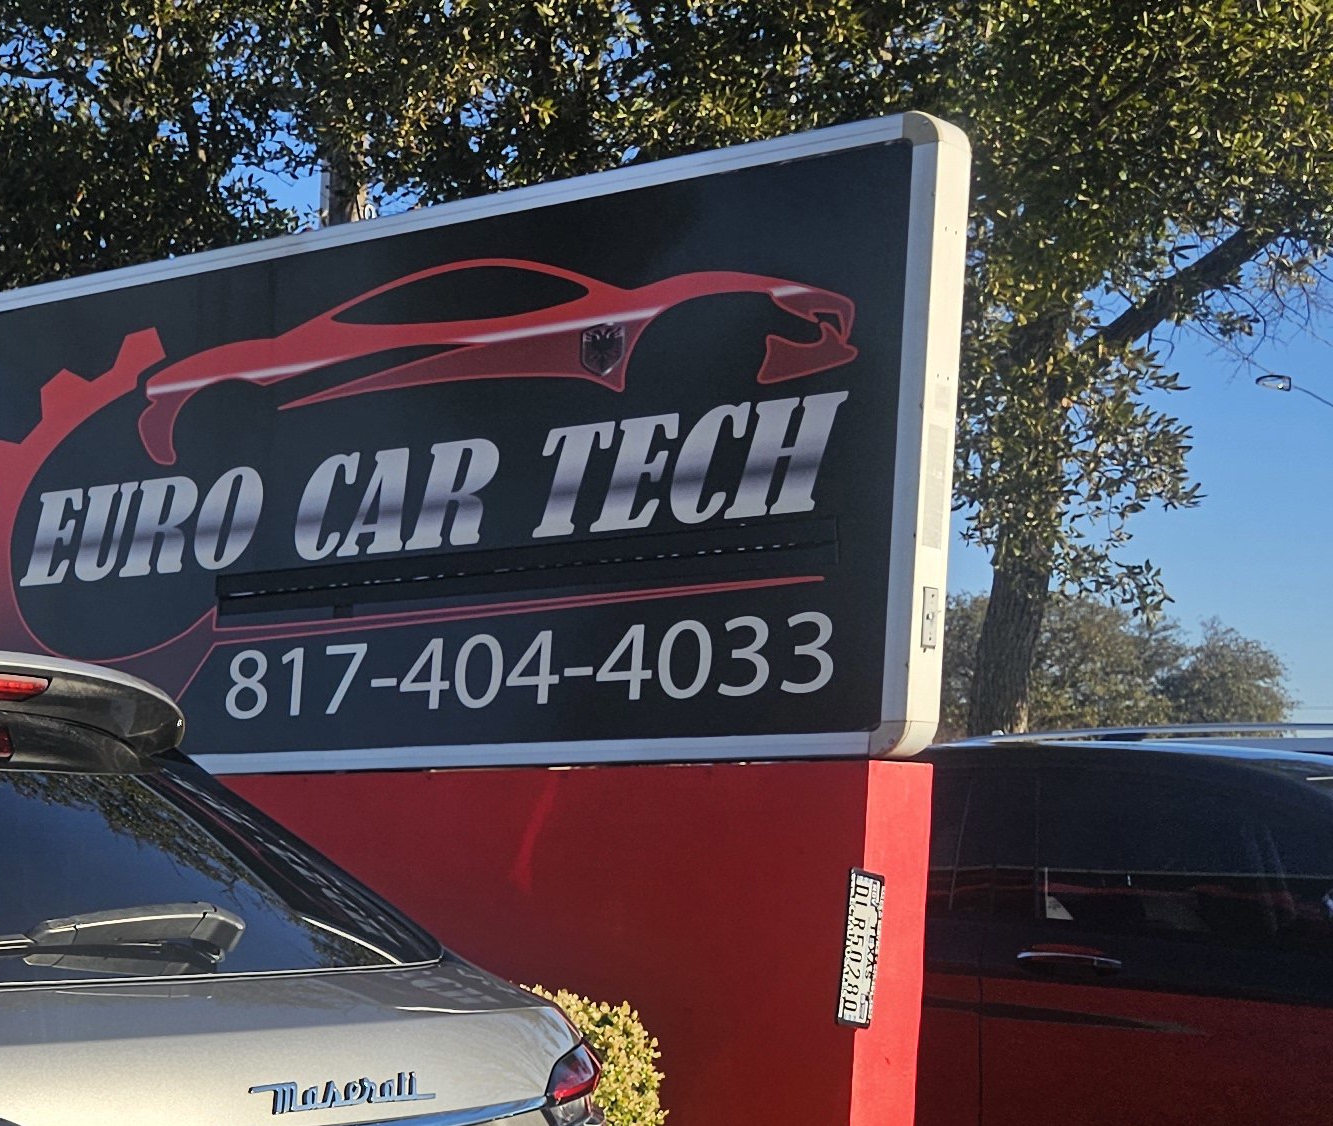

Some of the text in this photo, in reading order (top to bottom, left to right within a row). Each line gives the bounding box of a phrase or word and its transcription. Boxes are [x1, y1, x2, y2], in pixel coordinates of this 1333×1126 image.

[20, 390, 850, 588] EURO CAR TECH
[224, 611, 835, 720] 817-404-4033
[248, 1071, 436, 1115] Maserati
